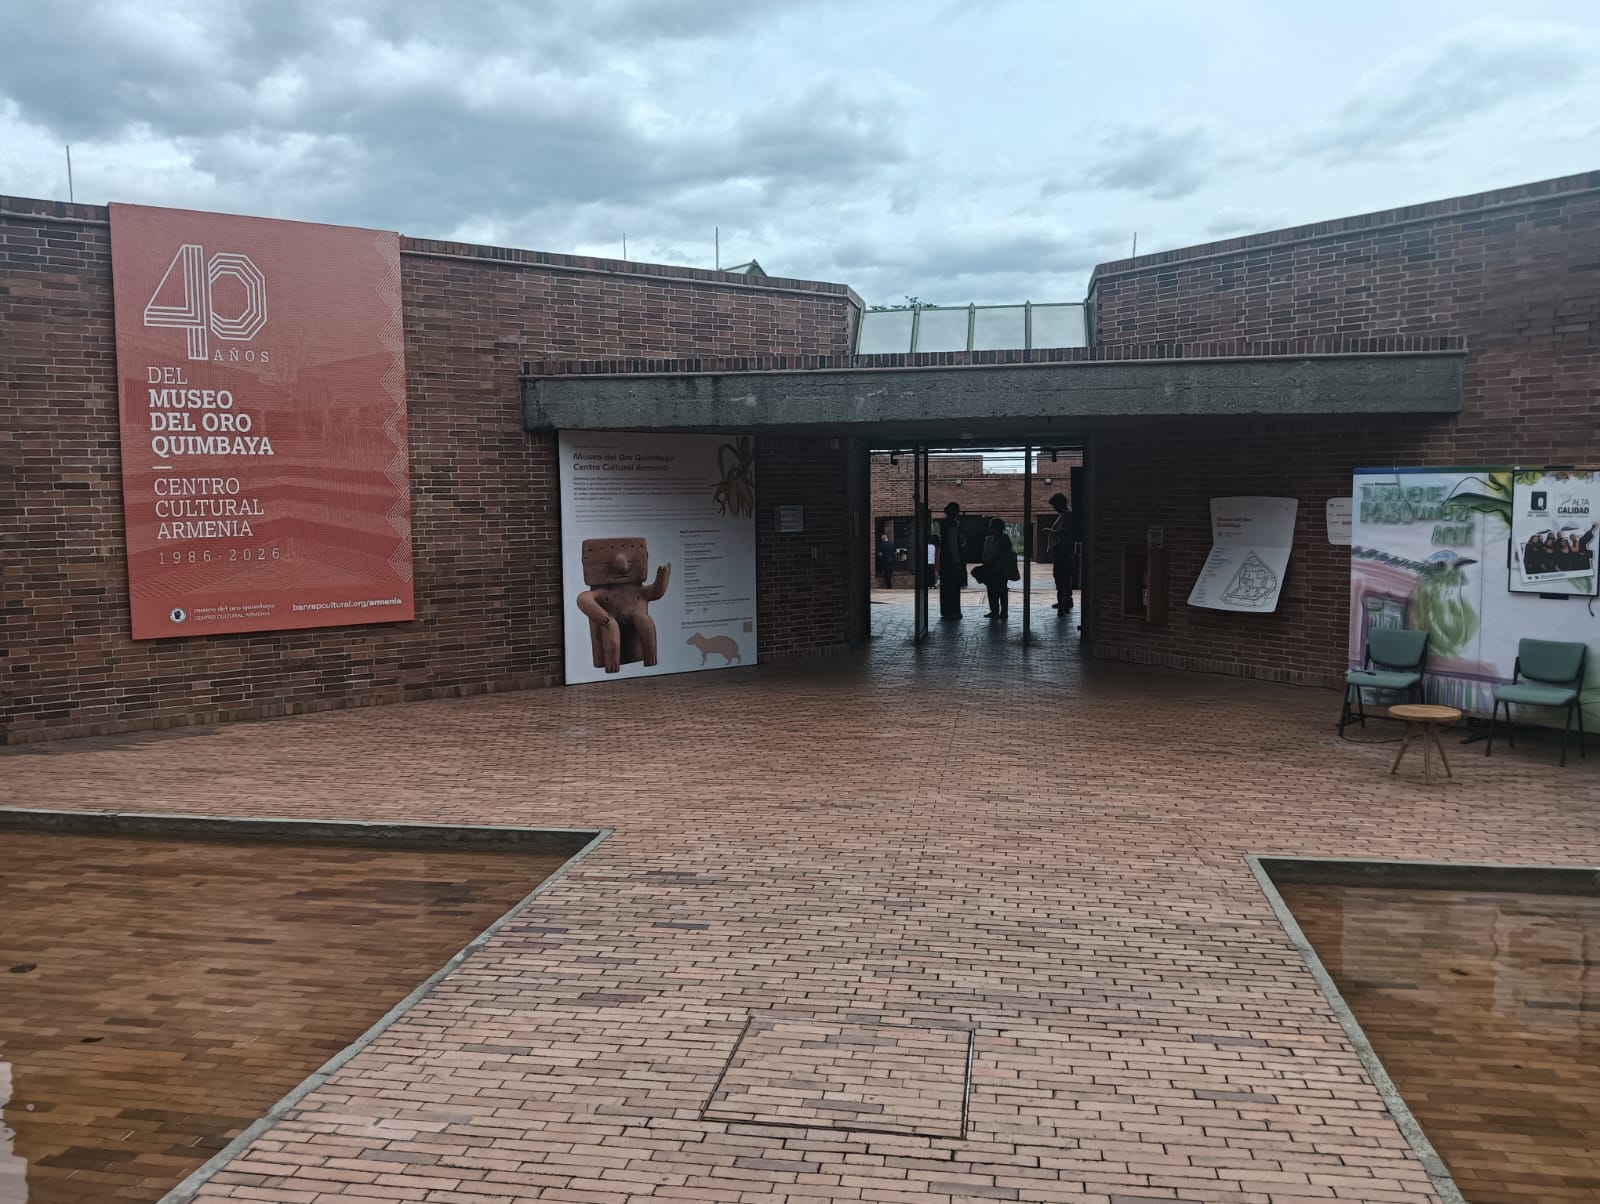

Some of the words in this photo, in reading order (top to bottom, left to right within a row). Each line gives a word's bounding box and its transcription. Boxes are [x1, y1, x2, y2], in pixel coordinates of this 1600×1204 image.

[144, 244, 268, 360] 40
[213, 347, 270, 363] AÑOS
[147, 366, 188, 384] DEL
[148, 389, 233, 409] MUSEO
[150, 412, 196, 432] DEL
[202, 413, 252, 432] ORO
[151, 435, 274, 458] QUIMBAYA
[573, 463, 601, 471] Centro
[602, 463, 634, 471] Cultural
[153, 477, 240, 496] CENTRO
[155, 499, 264, 518] CULTURAL
[1557, 506, 1590, 515] CALIDAD
[1572, 498, 1590, 506] ALTA
[156, 520, 253, 540] ARMENIA
[159, 547, 280, 565] 1986-2026
[292, 597, 402, 612] banrepcultural.org/armenia
